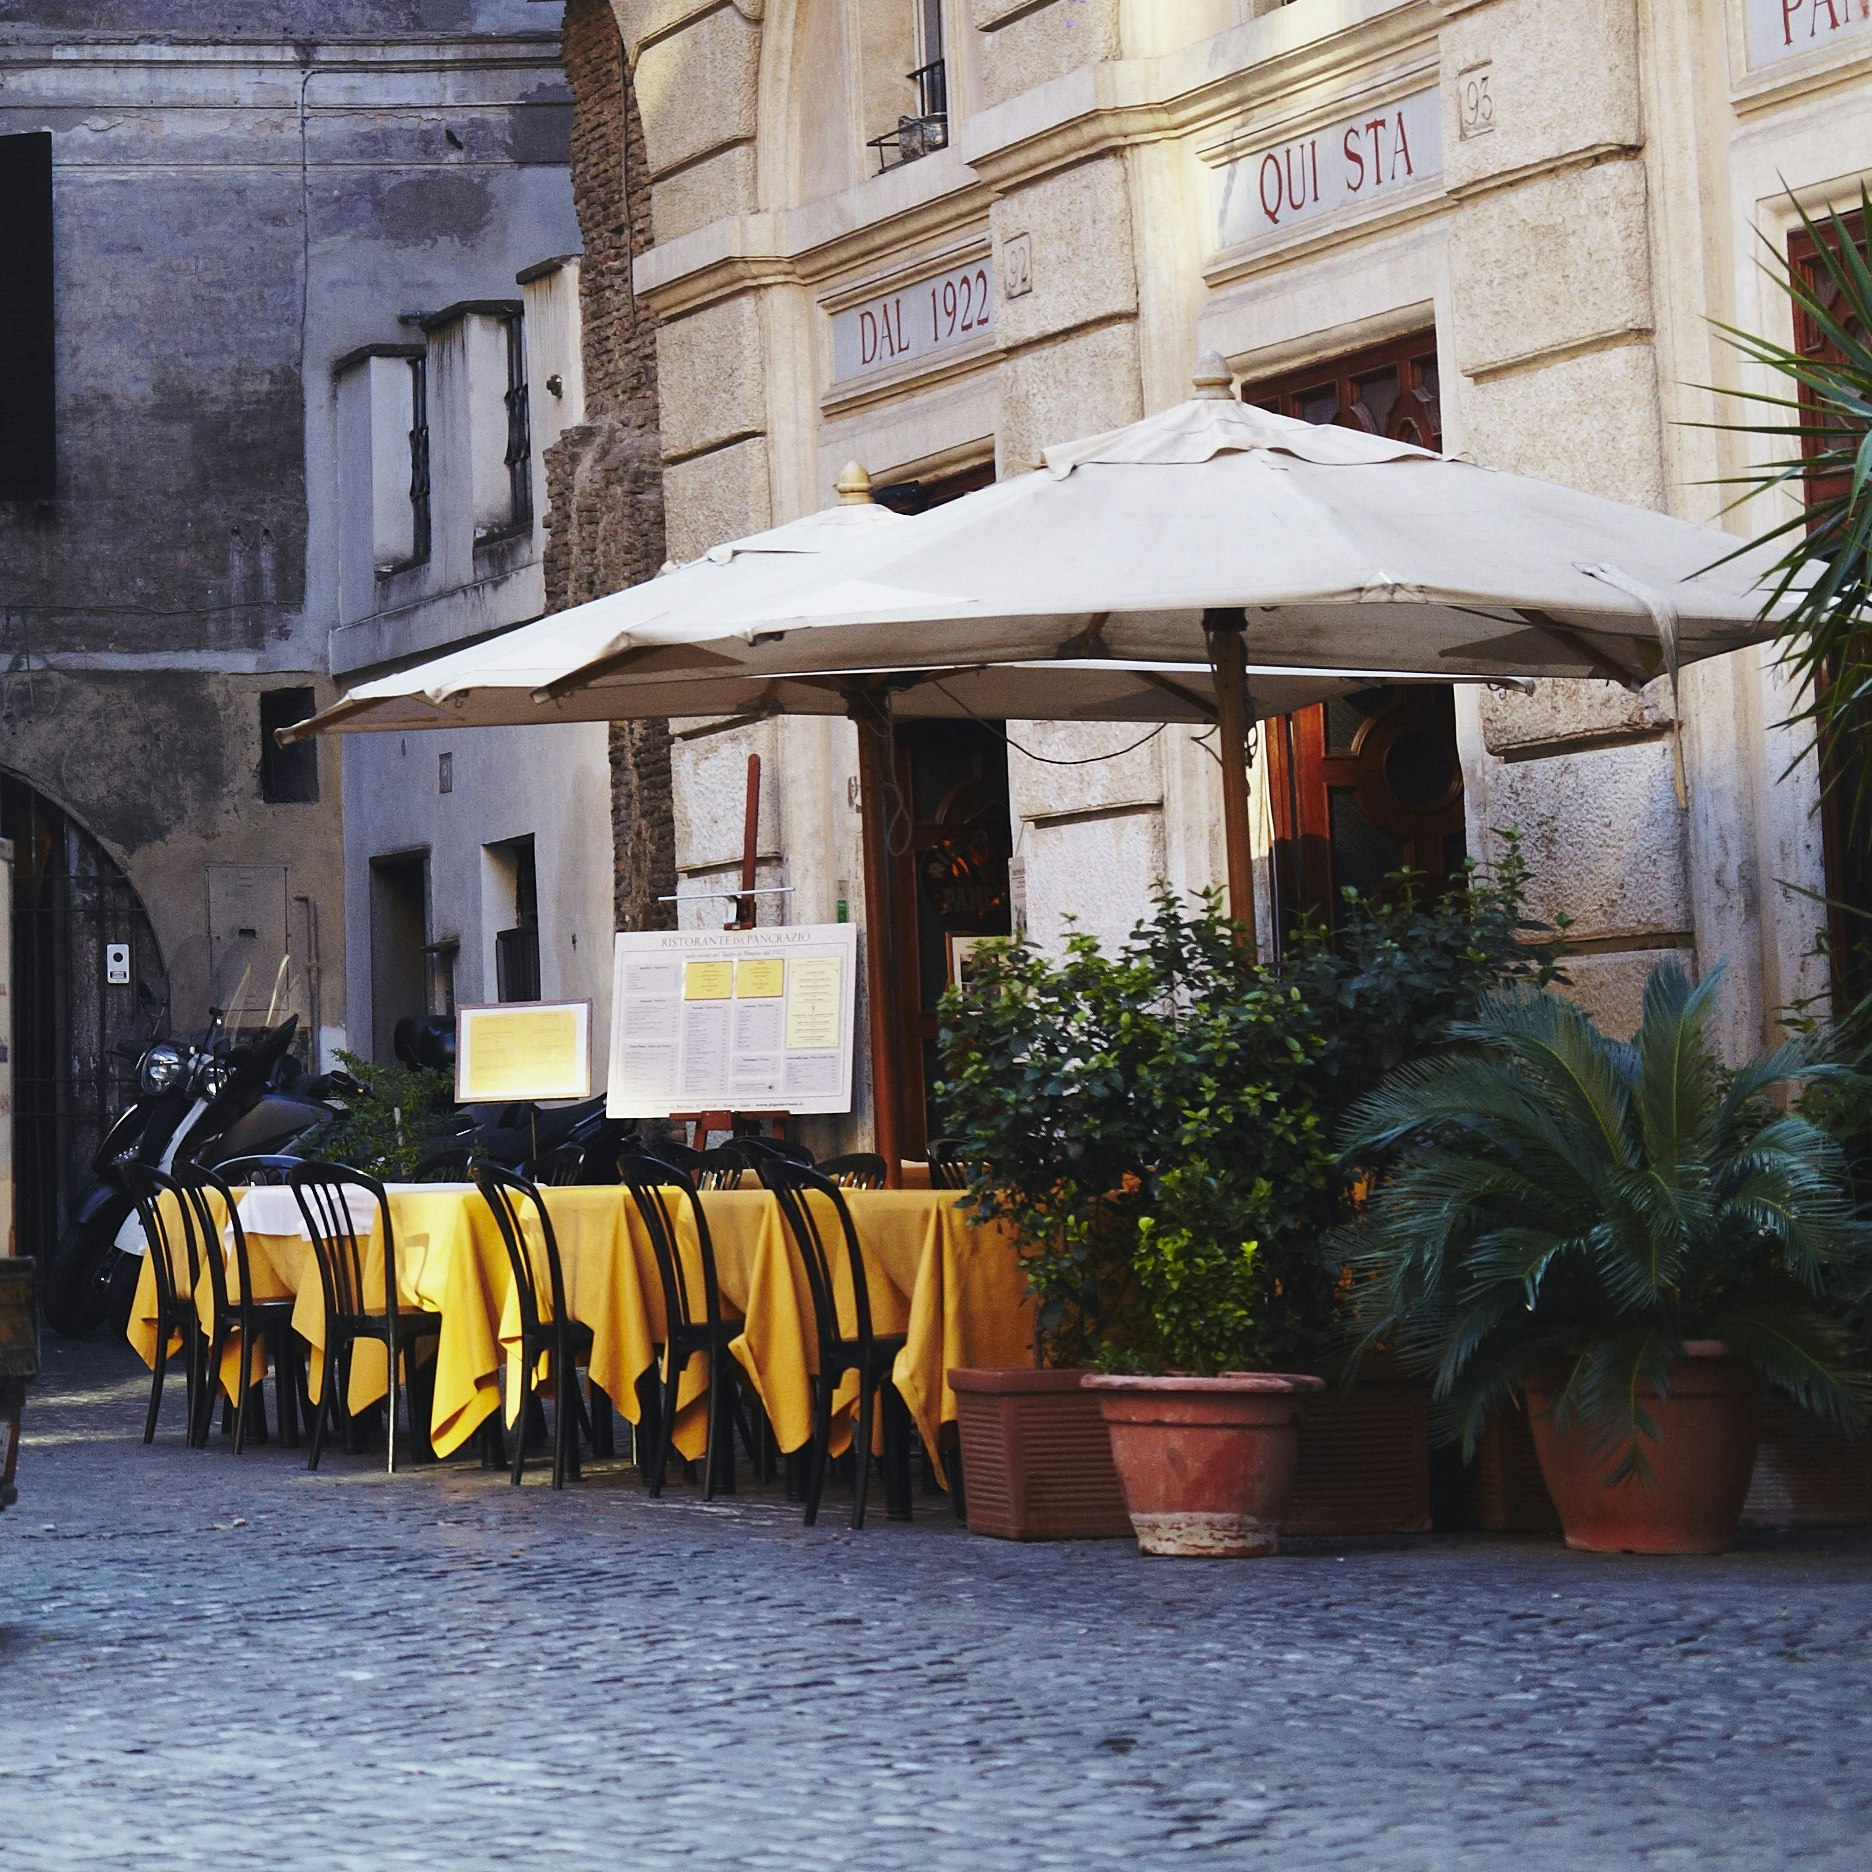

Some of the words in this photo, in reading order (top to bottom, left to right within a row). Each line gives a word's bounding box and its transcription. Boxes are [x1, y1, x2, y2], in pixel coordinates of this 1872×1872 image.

[1464, 75, 1493, 126] 93
[1259, 139, 1320, 225] QUI
[1343, 111, 1414, 192] STA
[859, 297, 910, 365] DAL
[930, 268, 989, 342] 1922
[661, 935, 730, 948] RISTORANTE
[747, 931, 811, 944] PANCRAZIO
